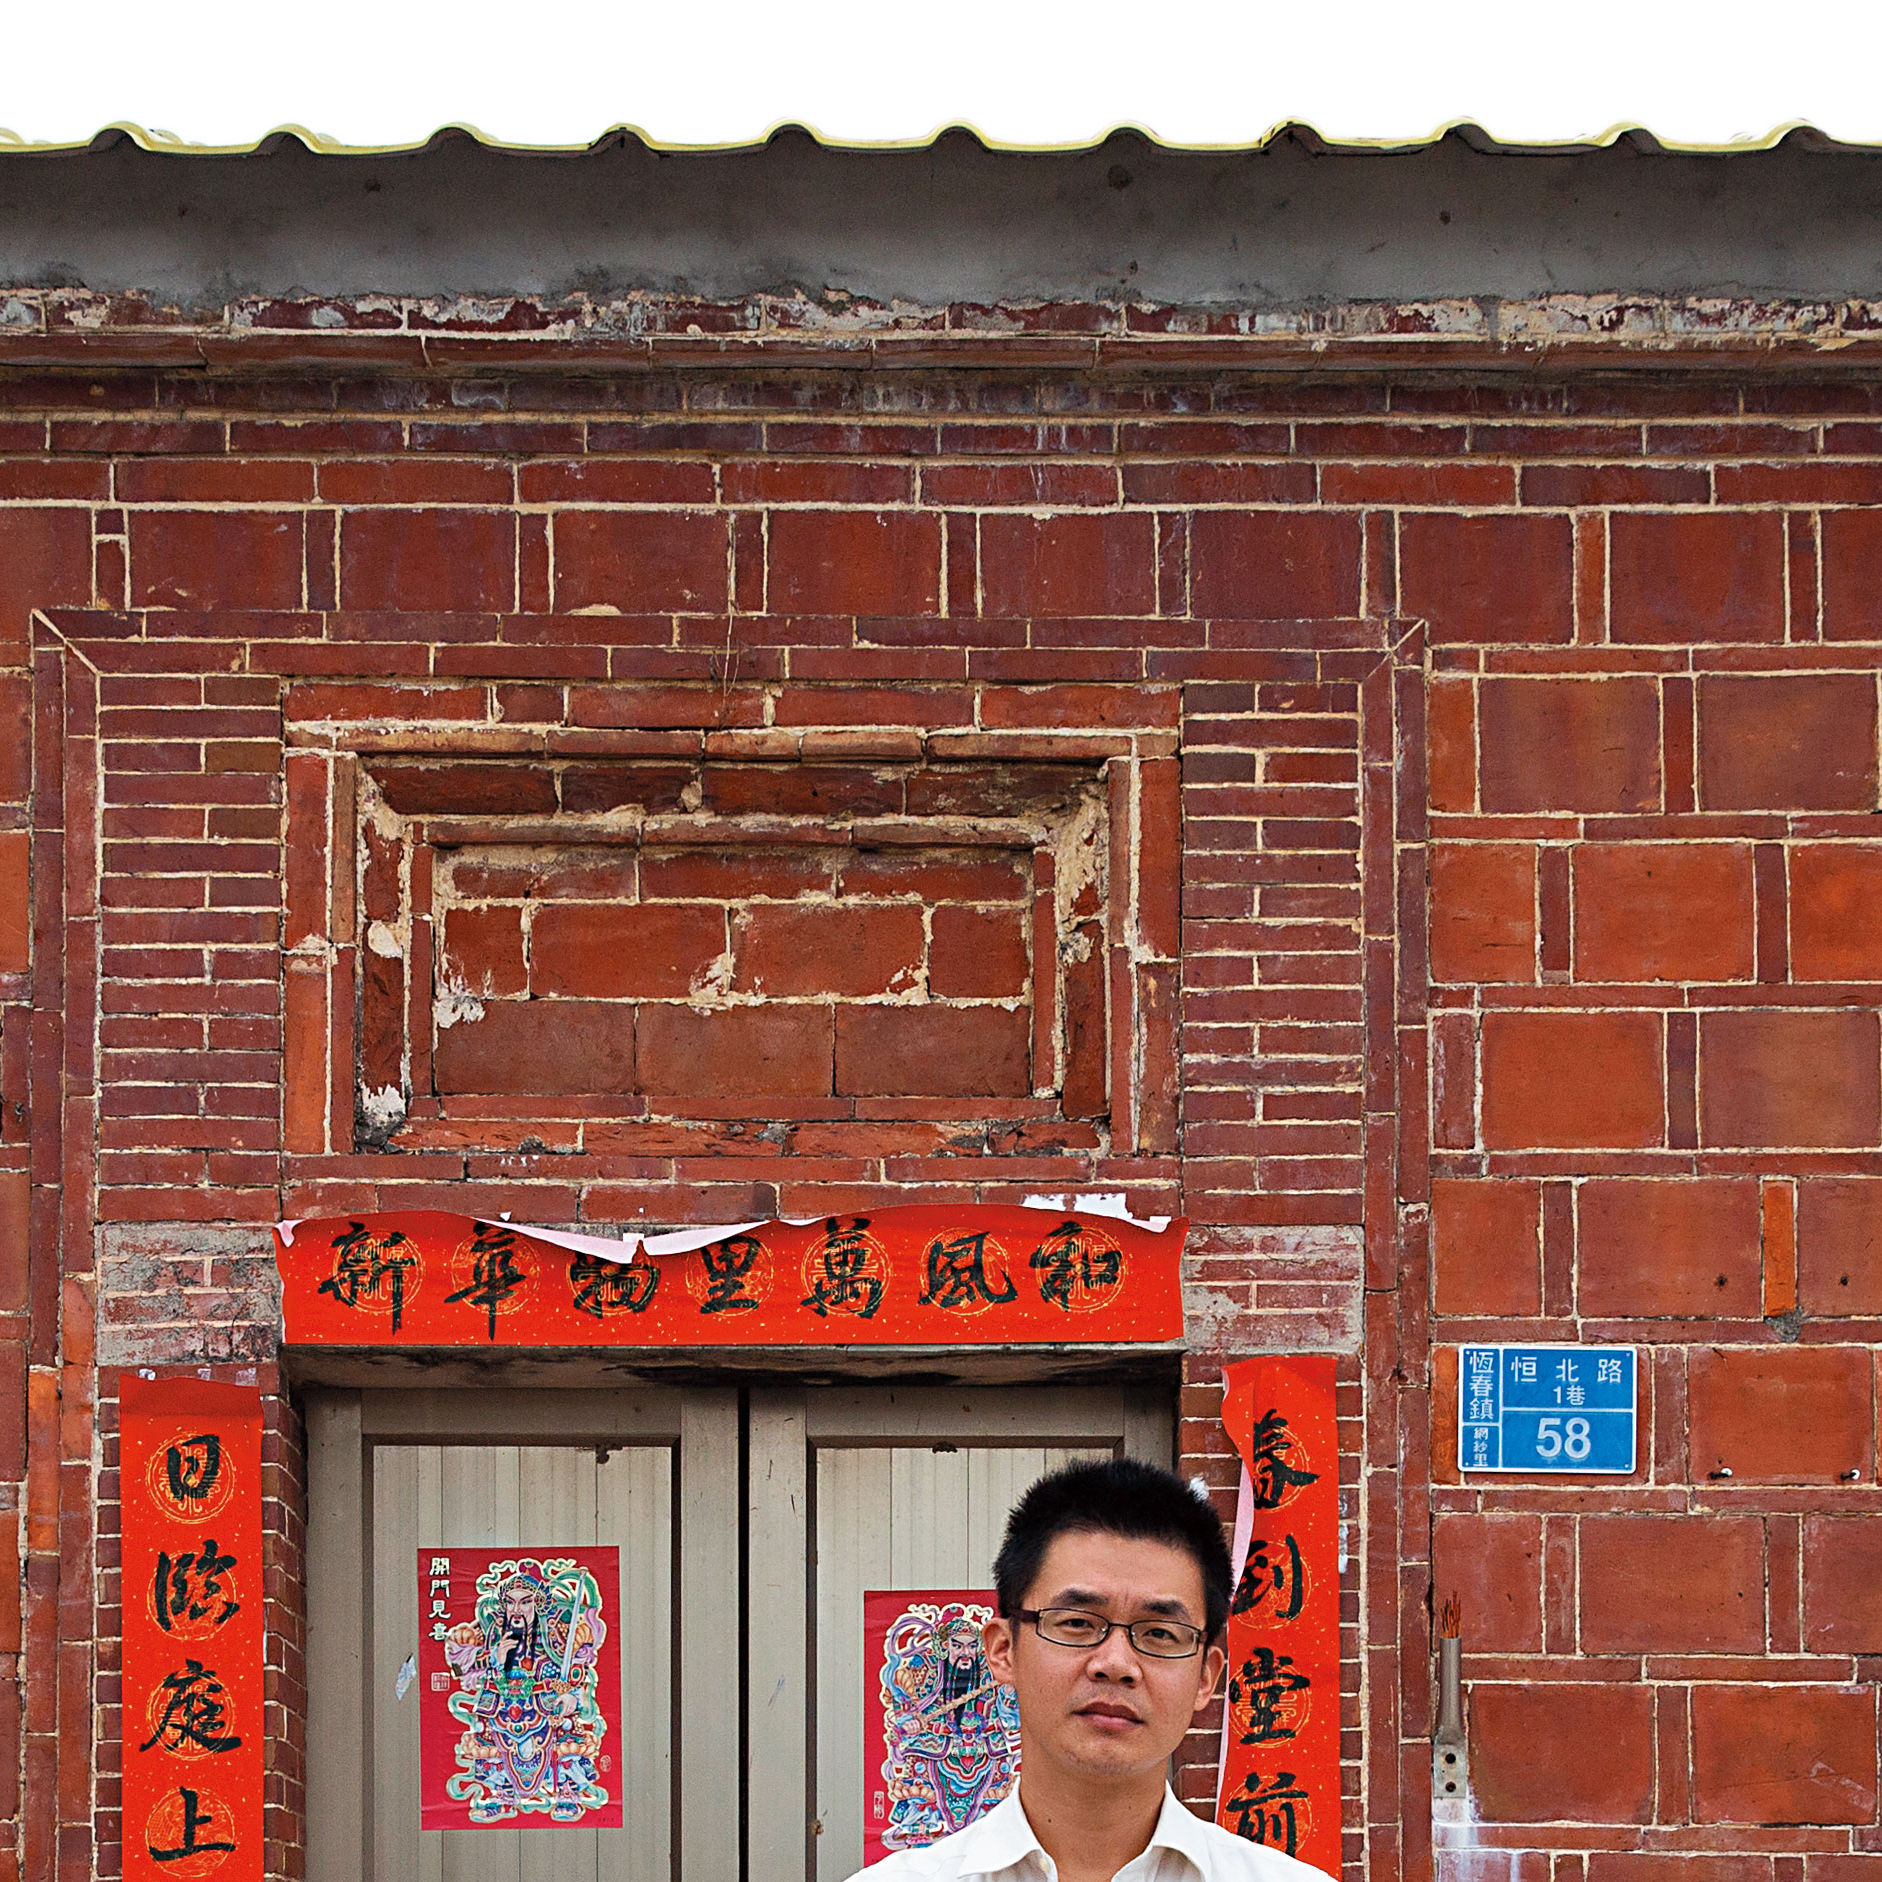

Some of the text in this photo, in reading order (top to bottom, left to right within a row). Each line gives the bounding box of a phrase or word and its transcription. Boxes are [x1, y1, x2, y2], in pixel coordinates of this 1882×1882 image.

[1553, 1385, 1586, 1405] 1巷
[1535, 1417, 1592, 1459] 58
[428, 1557, 452, 1641] 開門見喜
